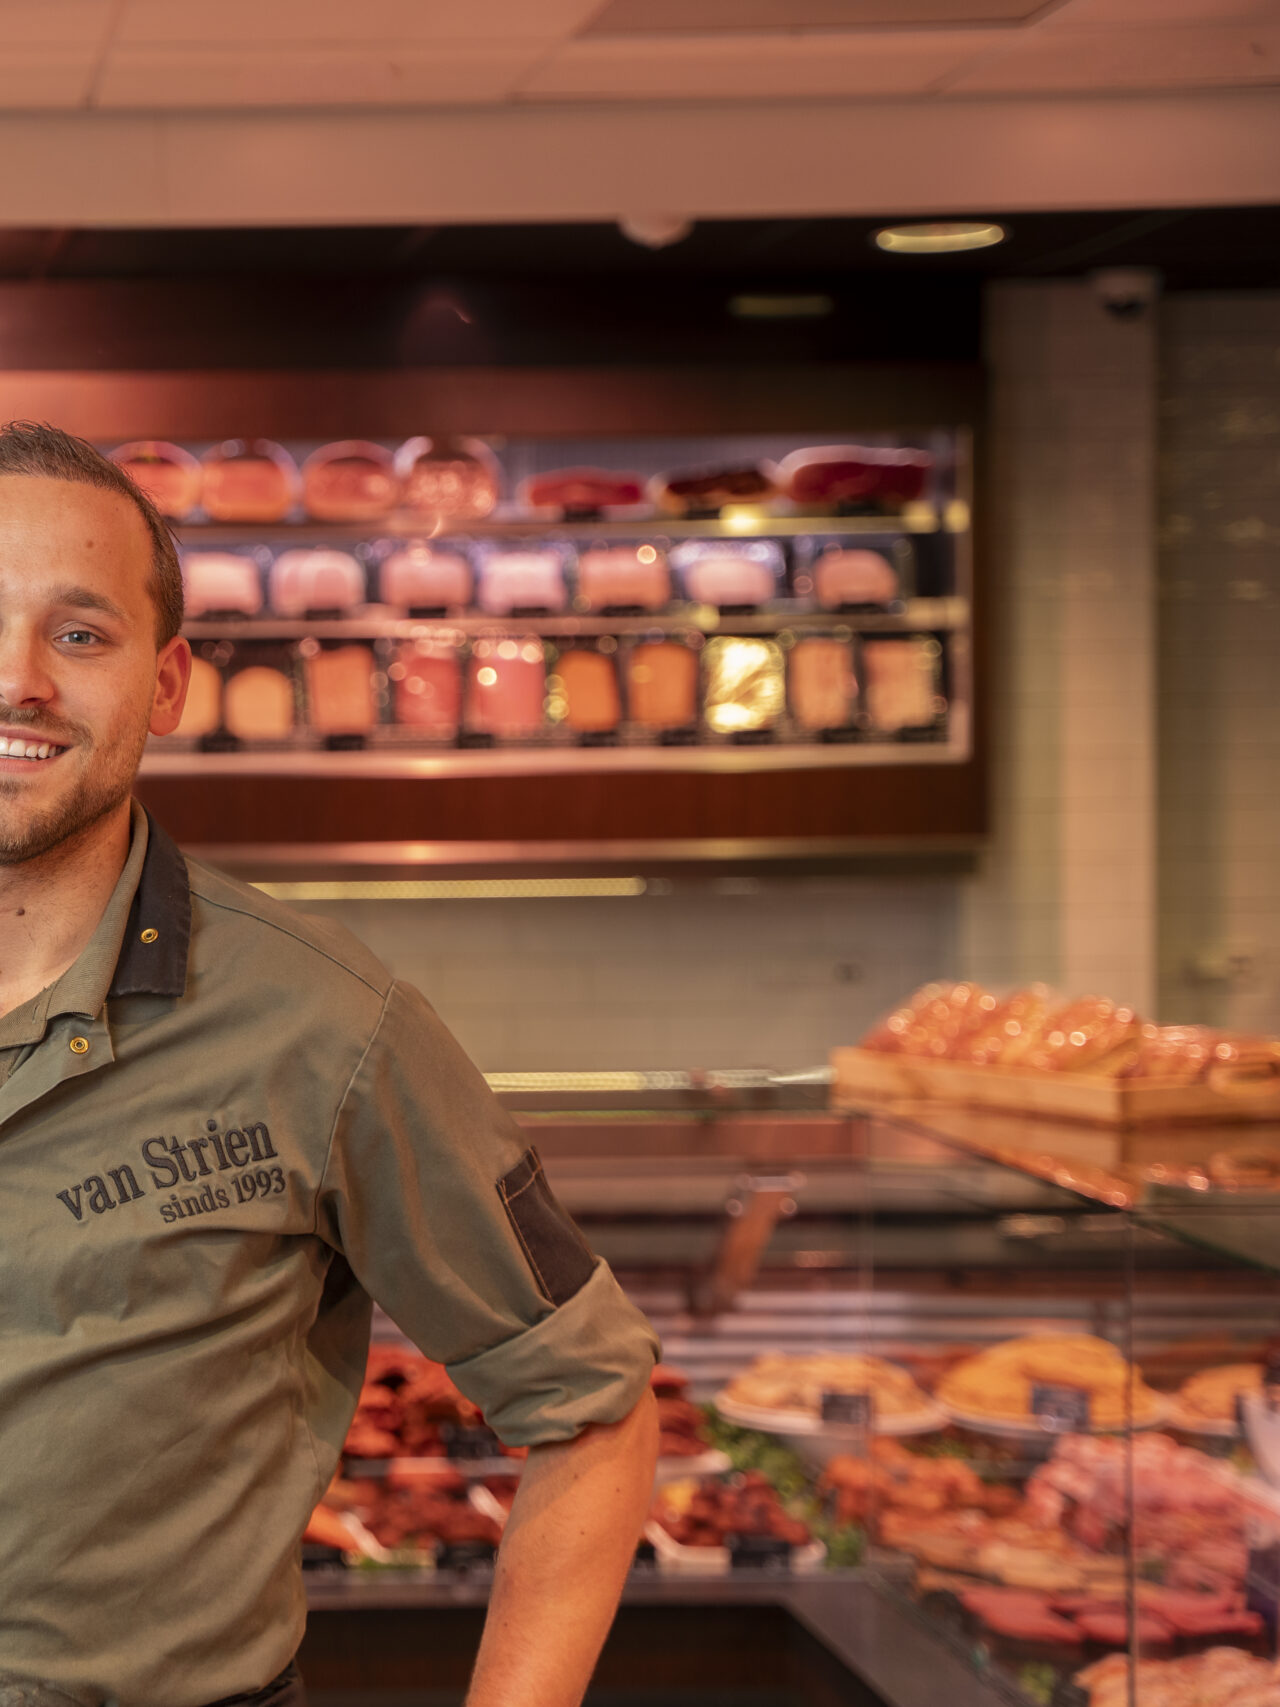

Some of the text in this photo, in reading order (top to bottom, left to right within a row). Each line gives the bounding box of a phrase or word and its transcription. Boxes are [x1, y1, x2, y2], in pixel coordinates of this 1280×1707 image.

[56, 1119, 278, 1221] van Strien
[159, 1167, 286, 1223] sinds 1993
